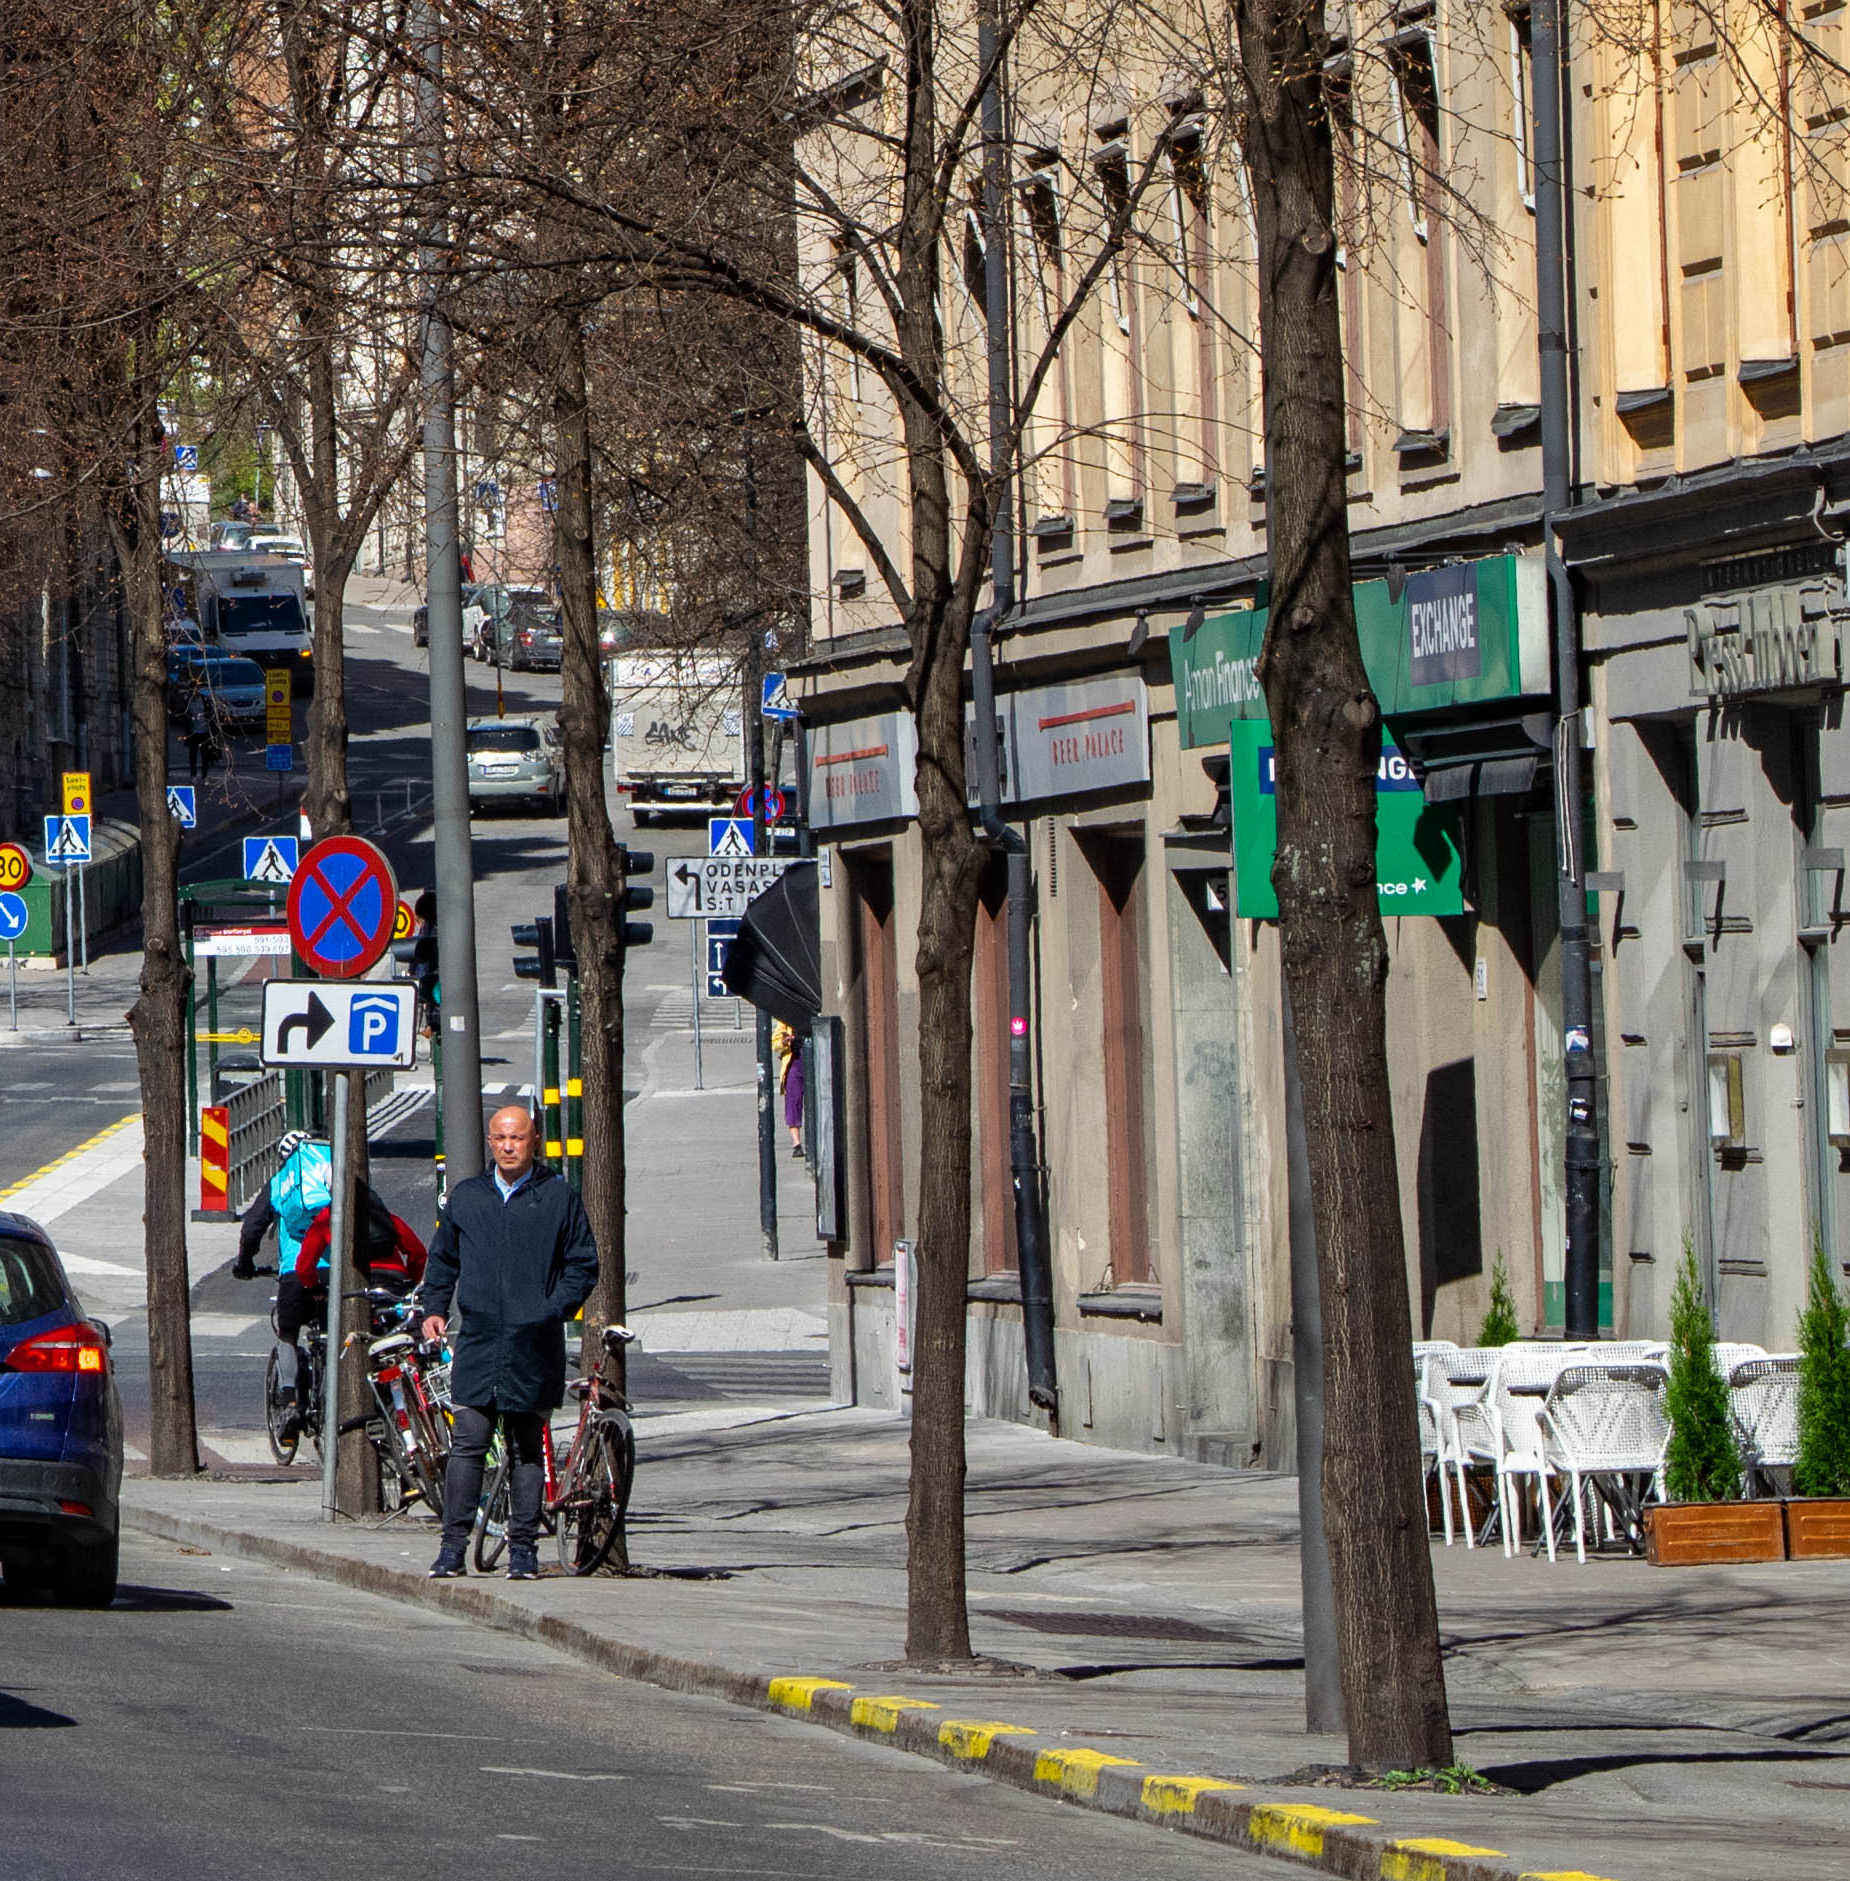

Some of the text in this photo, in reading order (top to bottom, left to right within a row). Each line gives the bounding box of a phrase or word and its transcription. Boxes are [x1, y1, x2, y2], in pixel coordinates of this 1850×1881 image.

[1412, 593, 1475, 658] EXCHANGE
[1052, 728, 1125, 767] BEER PALACE
[706, 863, 783, 877] ODENPL
[706, 880, 773, 894] VASAS
[706, 897, 734, 911] S:T
[362, 1011, 387, 1051] P
